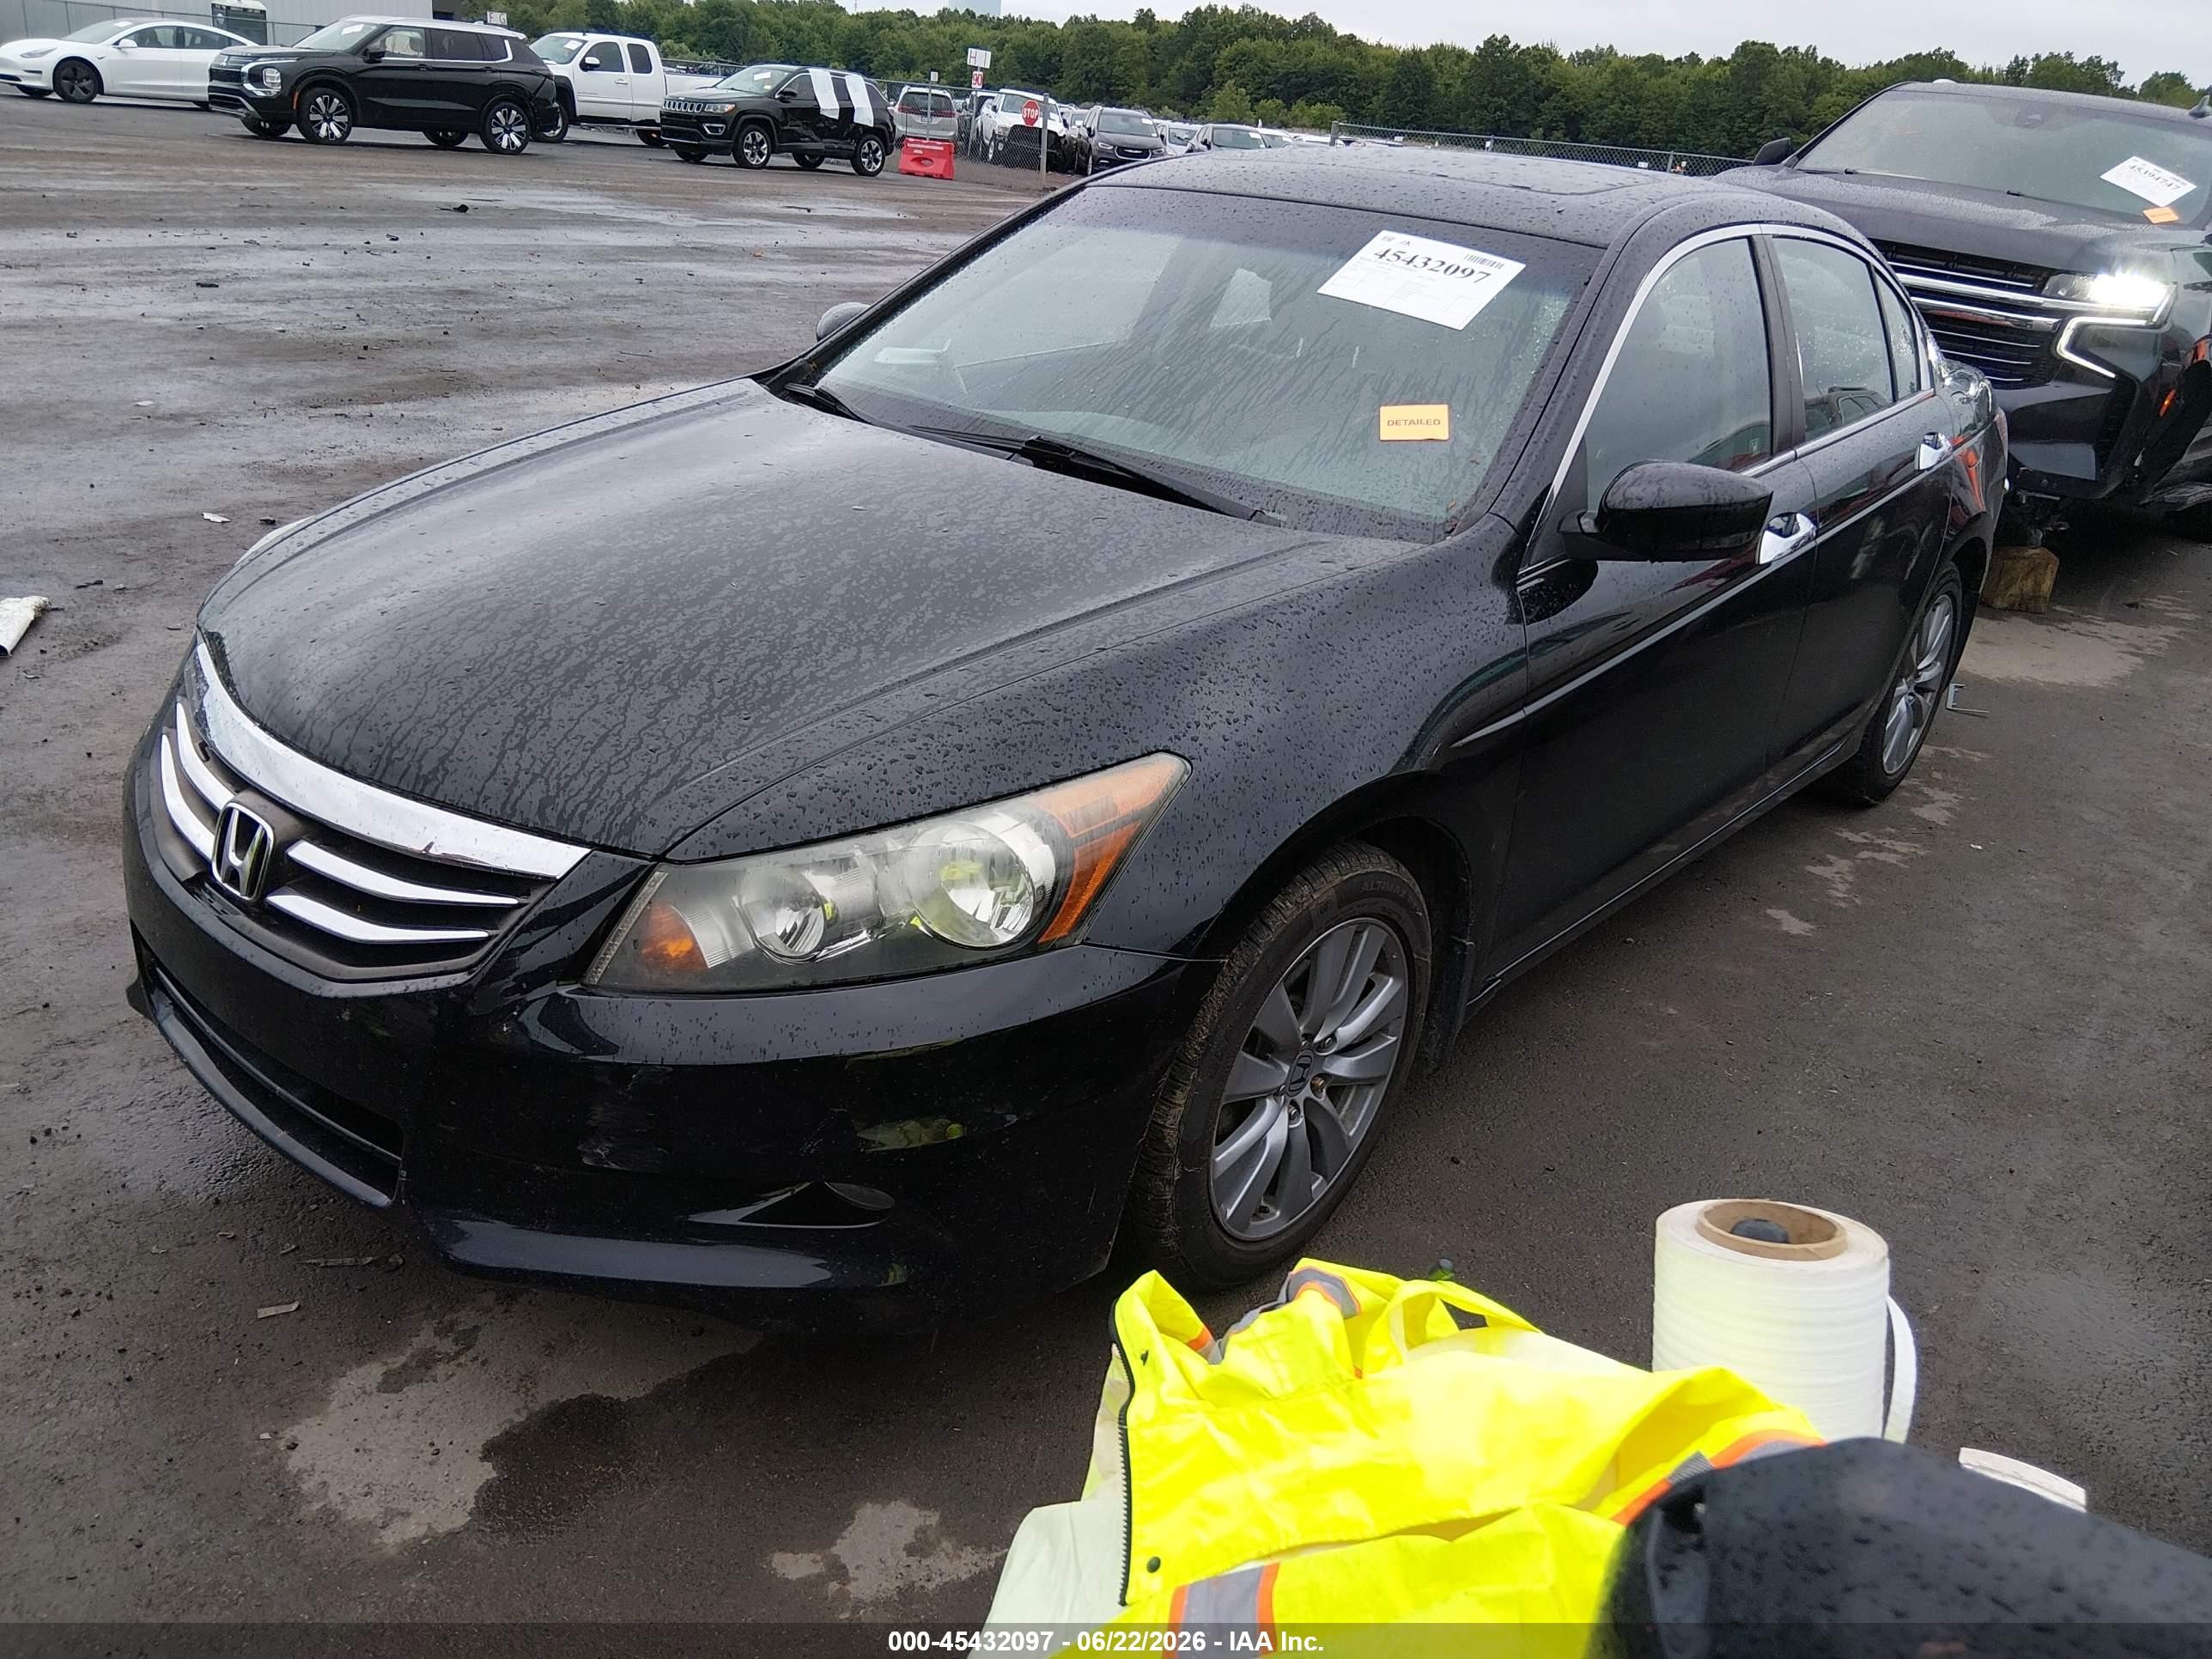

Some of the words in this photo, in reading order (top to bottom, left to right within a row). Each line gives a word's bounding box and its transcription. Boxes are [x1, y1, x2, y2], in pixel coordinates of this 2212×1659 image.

[969, 50, 977, 65] H
[972, 73, 983, 86] 90
[1023, 107, 1039, 119] STOP
[1374, 247, 1492, 283] 45432097
[1387, 418, 1441, 427] DETAILED
